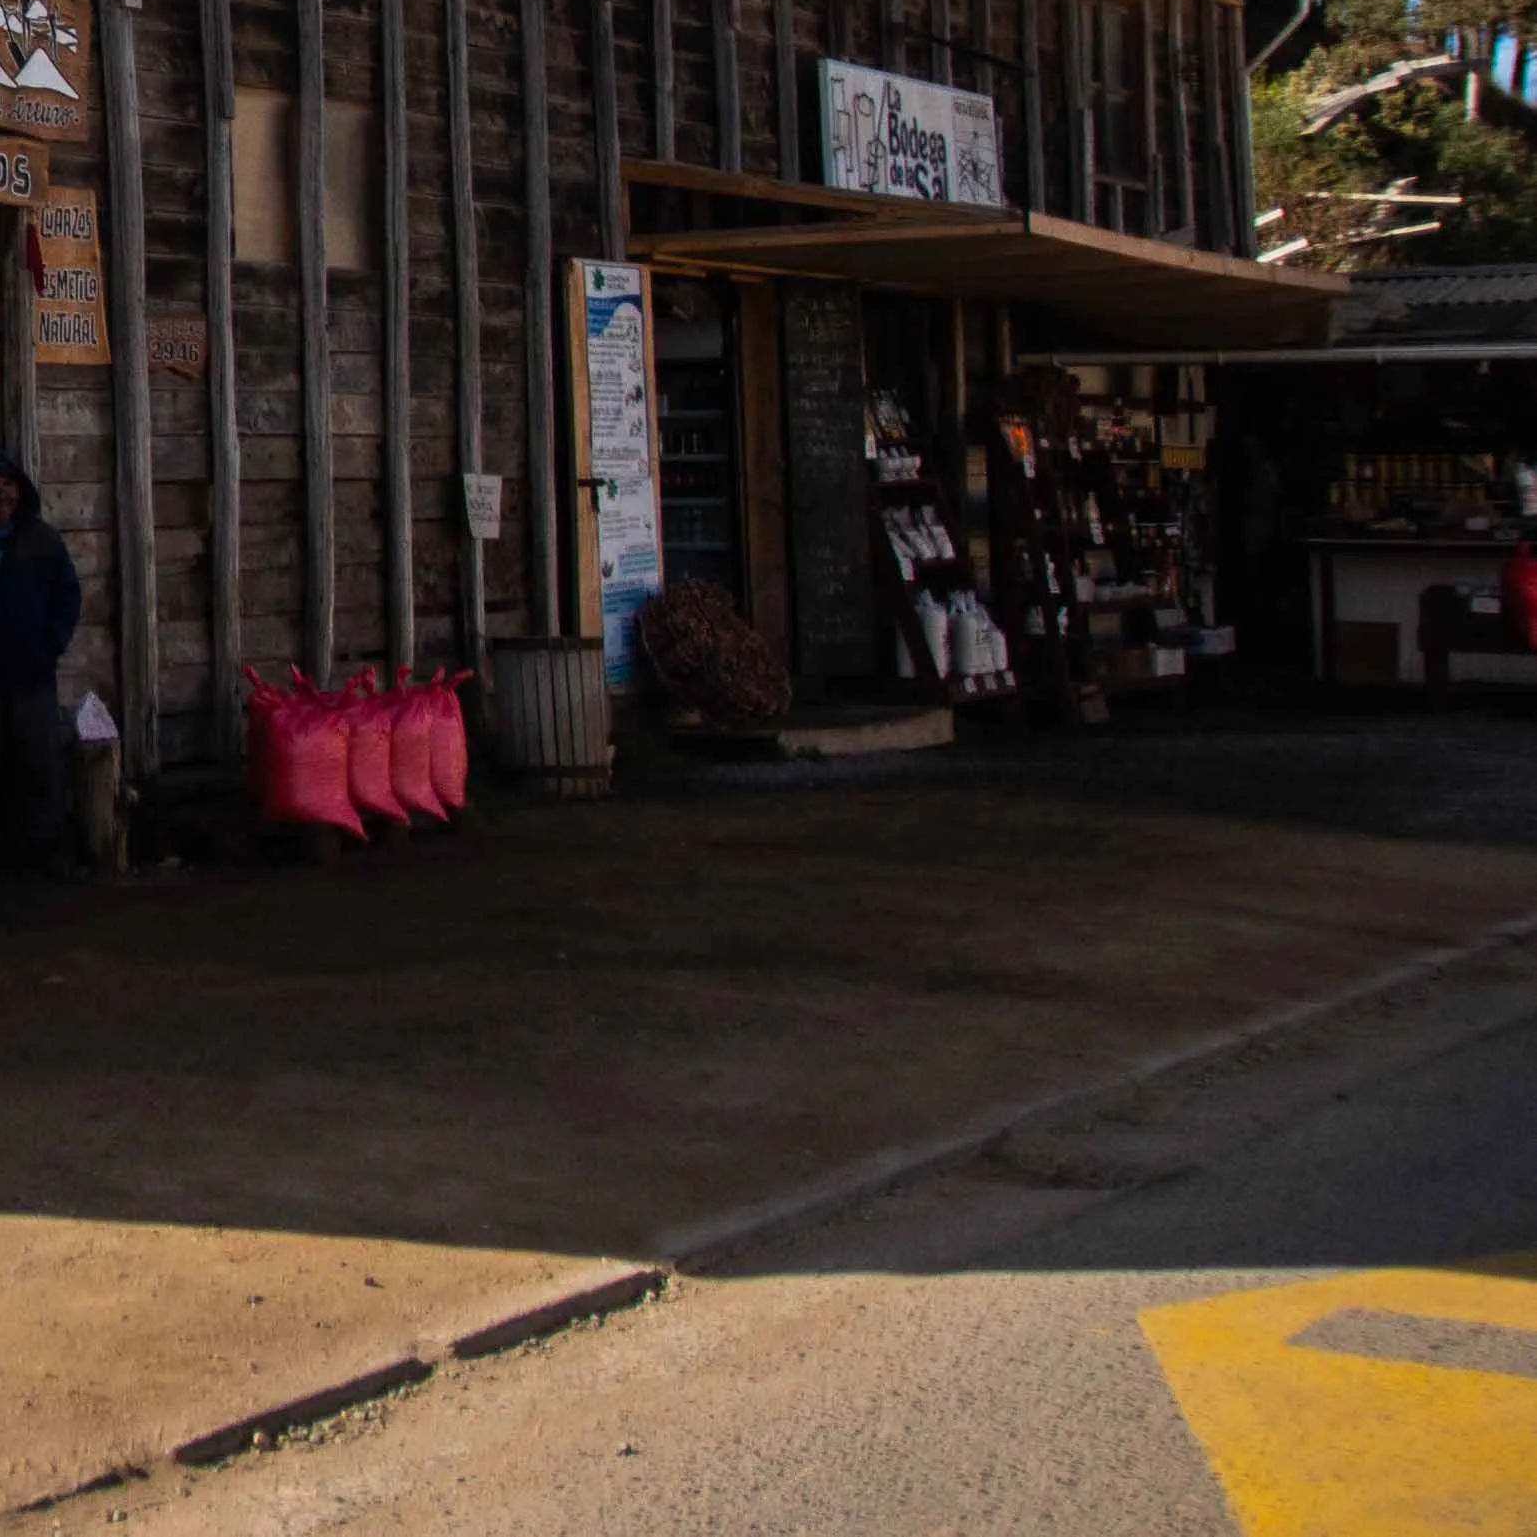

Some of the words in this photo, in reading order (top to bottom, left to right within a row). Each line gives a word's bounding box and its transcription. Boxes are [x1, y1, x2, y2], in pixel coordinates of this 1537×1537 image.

[888, 112, 946, 172] Bodega
[40, 206, 92, 240] CUARZOS
[39, 311, 99, 345] NATURAL
[151, 341, 200, 363] 2946
